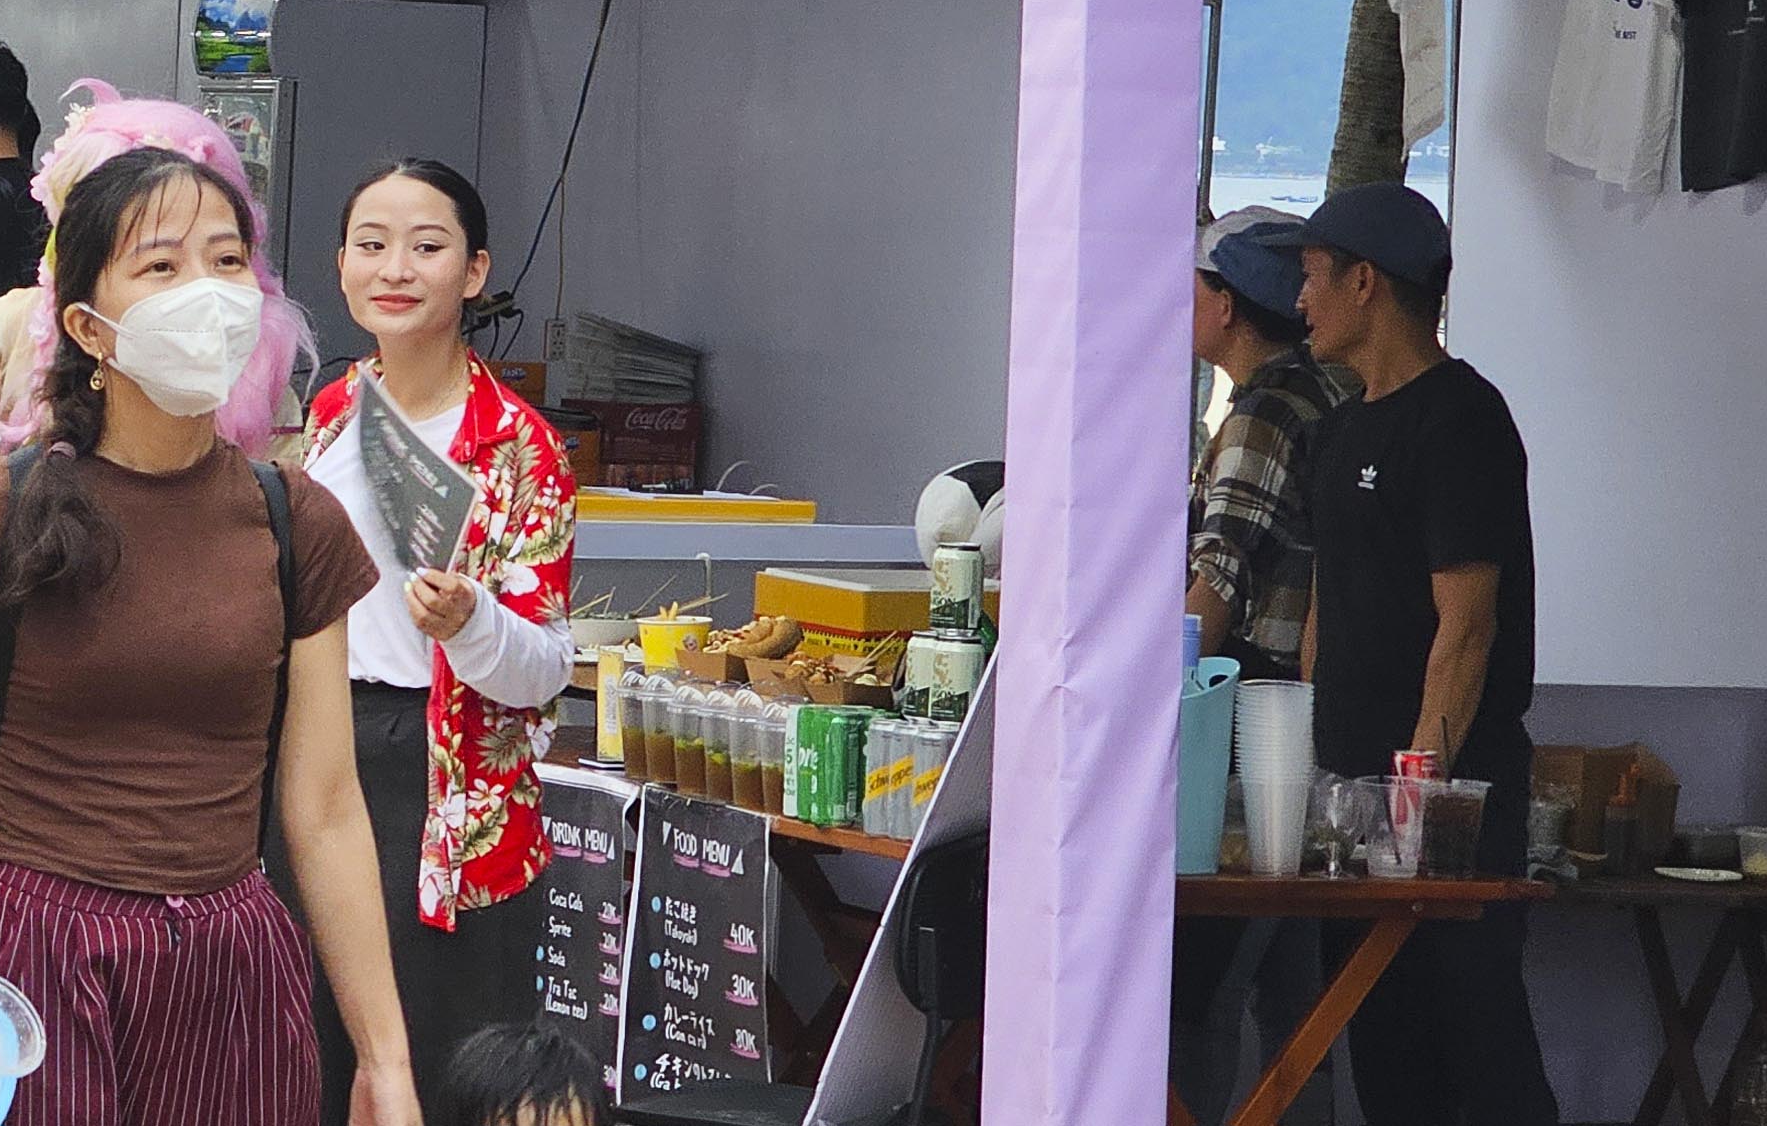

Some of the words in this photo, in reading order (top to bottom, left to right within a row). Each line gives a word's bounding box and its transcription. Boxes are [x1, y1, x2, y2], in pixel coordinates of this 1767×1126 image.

[552, 821, 582, 847] DRINK
[585, 828, 608, 853] MENU
[674, 828, 697, 856] FOOD
[702, 839, 730, 866] MENU
[549, 887, 567, 908] Coca
[665, 895, 696, 925] たこ焼き
[730, 923, 755, 948] 40K
[548, 945, 566, 967] Soda
[732, 974, 755, 1000] 30K
[735, 1028, 757, 1054] 80K
